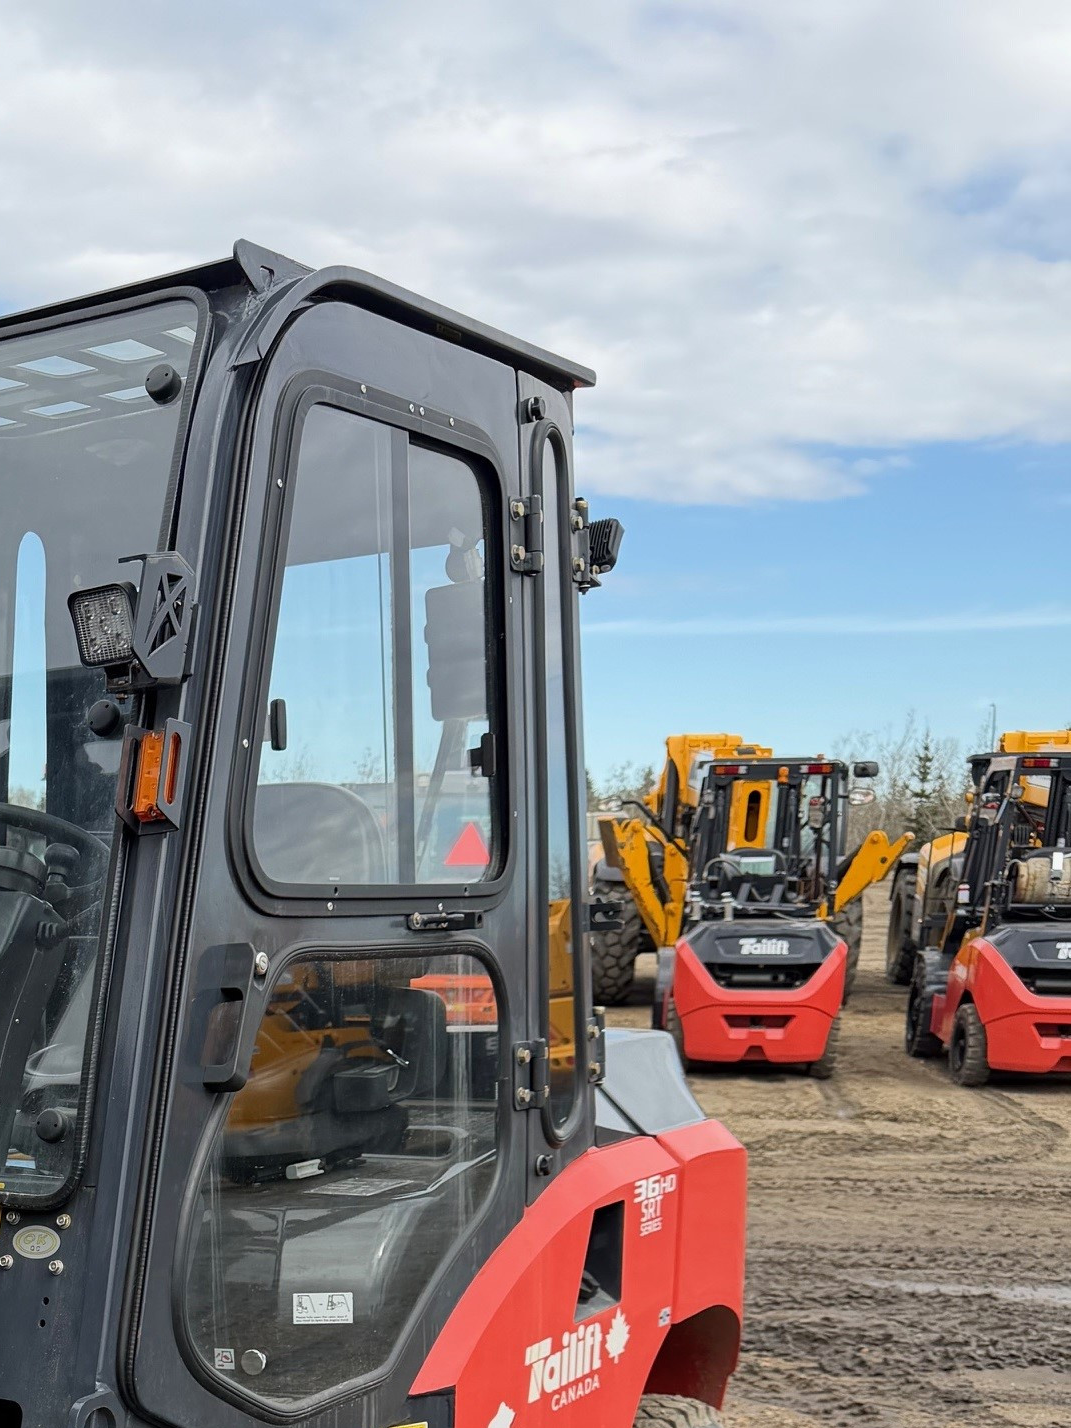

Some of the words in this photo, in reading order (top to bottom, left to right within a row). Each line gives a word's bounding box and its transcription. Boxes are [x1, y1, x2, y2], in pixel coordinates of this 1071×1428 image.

[739, 938, 789, 955] Tailift
[640, 1195, 664, 1222] SRT
[24, 1232, 49, 1245] OK
[525, 1323, 602, 1403] Tailift
[551, 1374, 600, 1411] CANADA
